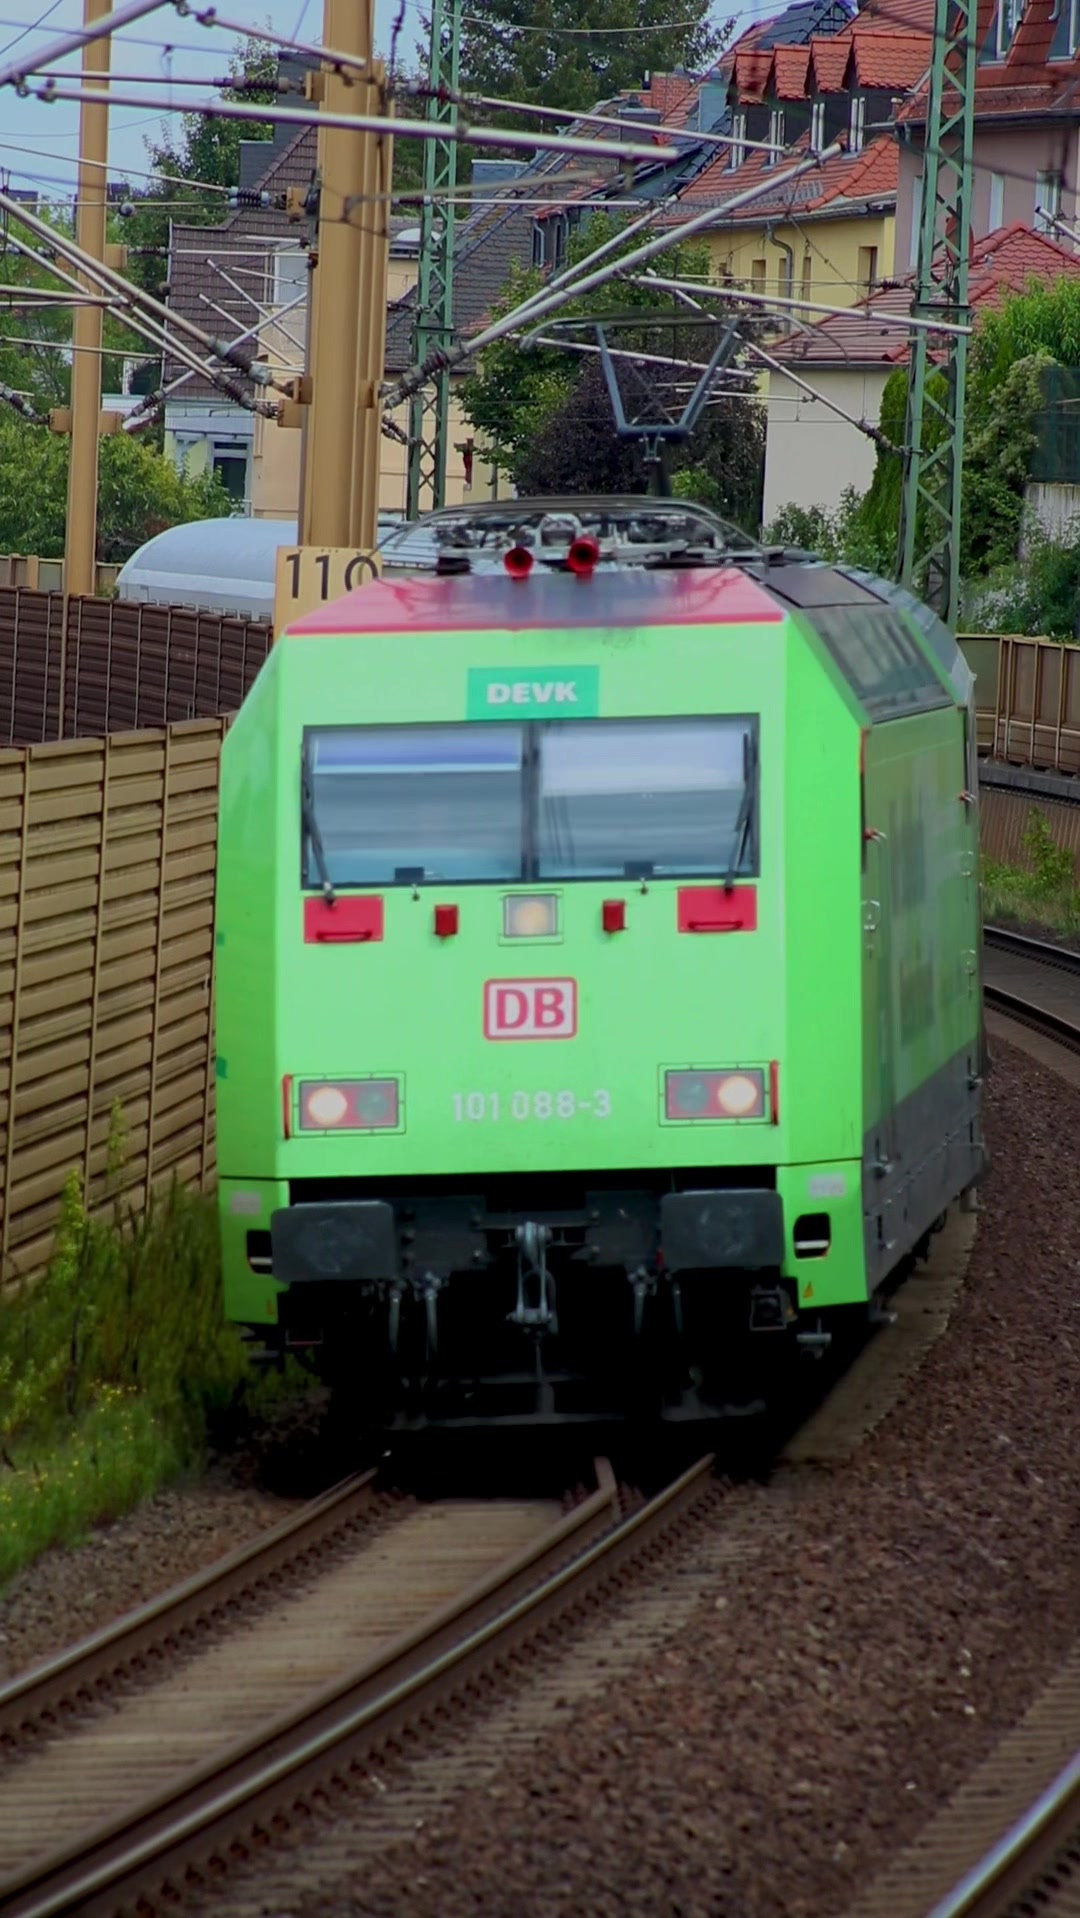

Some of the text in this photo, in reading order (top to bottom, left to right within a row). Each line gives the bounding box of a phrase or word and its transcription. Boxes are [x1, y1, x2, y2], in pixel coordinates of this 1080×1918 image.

[286, 554, 378, 600] 110
[487, 681, 577, 703] DEVK
[496, 987, 565, 1029] DB
[453, 1088, 611, 1121] 101 088-3
